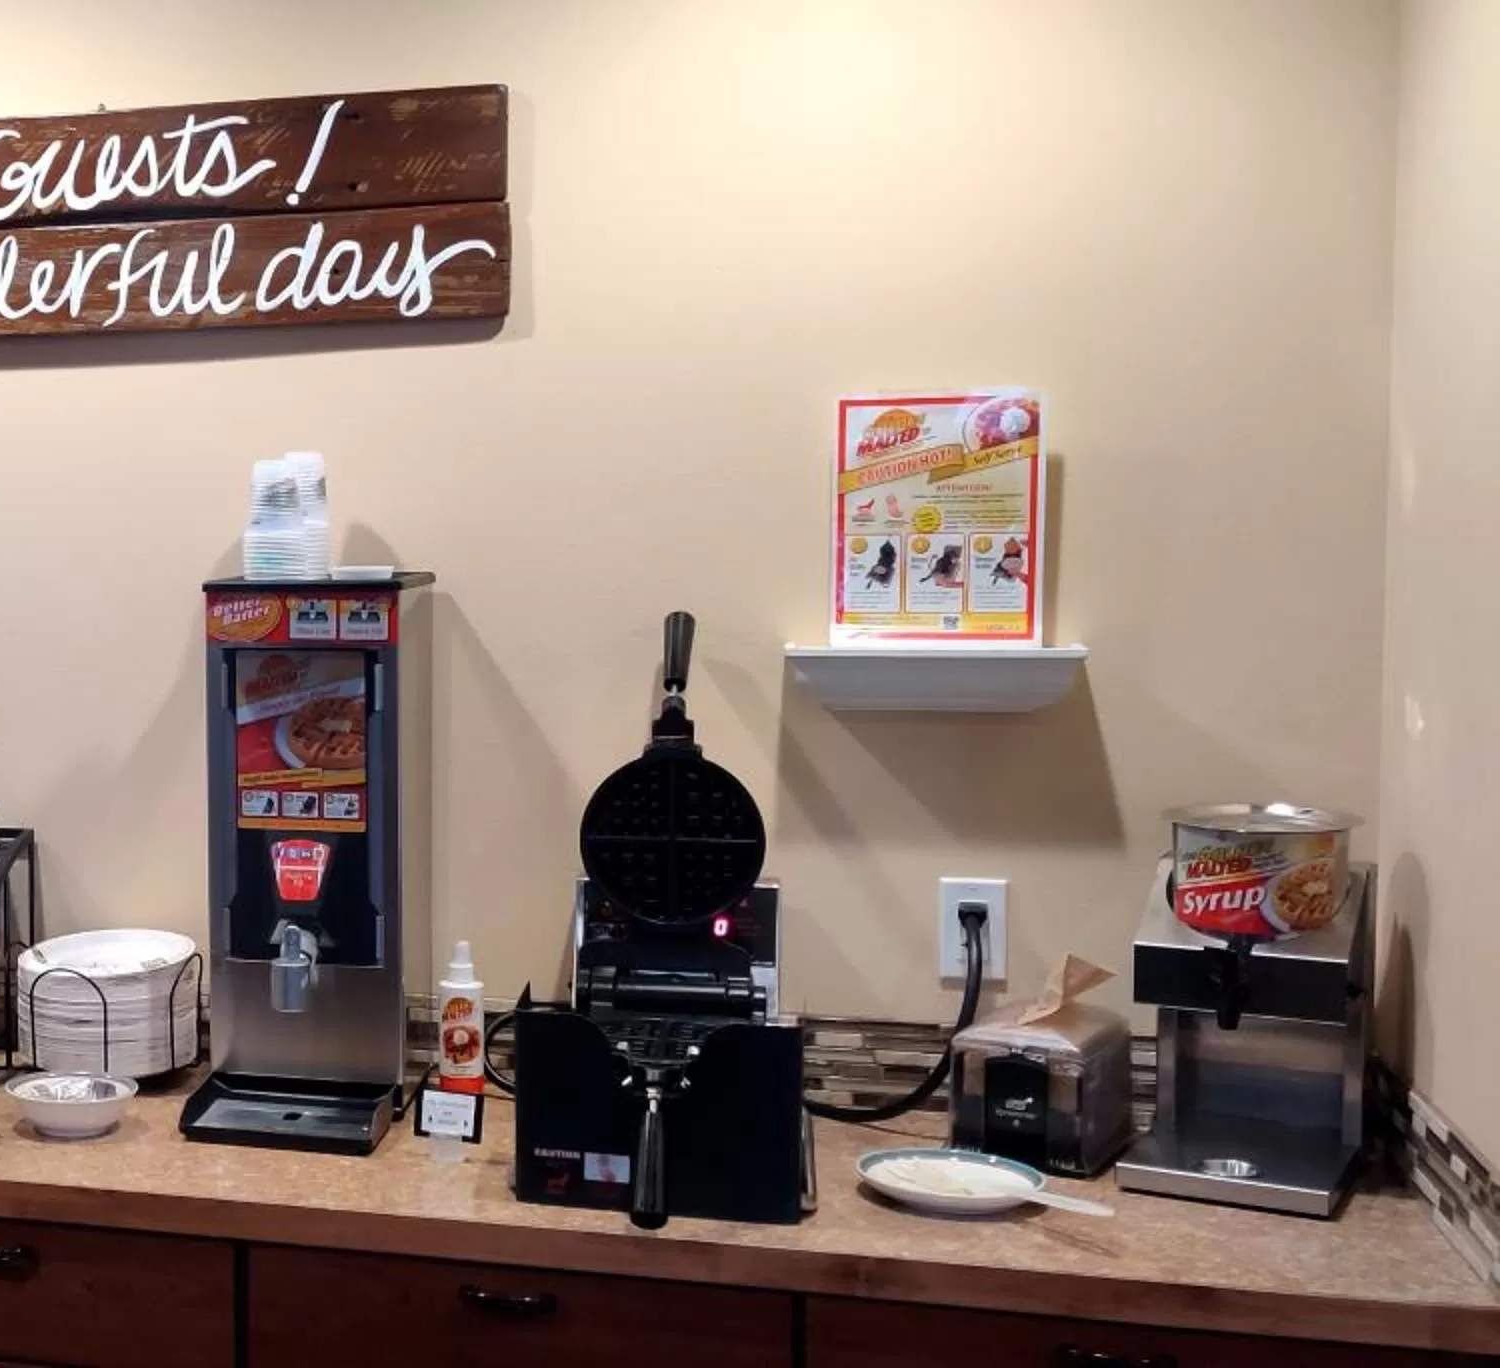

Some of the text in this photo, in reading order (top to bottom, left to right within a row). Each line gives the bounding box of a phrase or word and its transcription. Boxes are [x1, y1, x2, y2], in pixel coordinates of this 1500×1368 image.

[255, 222, 496, 318] day
[1182, 887, 1266, 916] Syrup
[713, 918, 729, 937] 0
